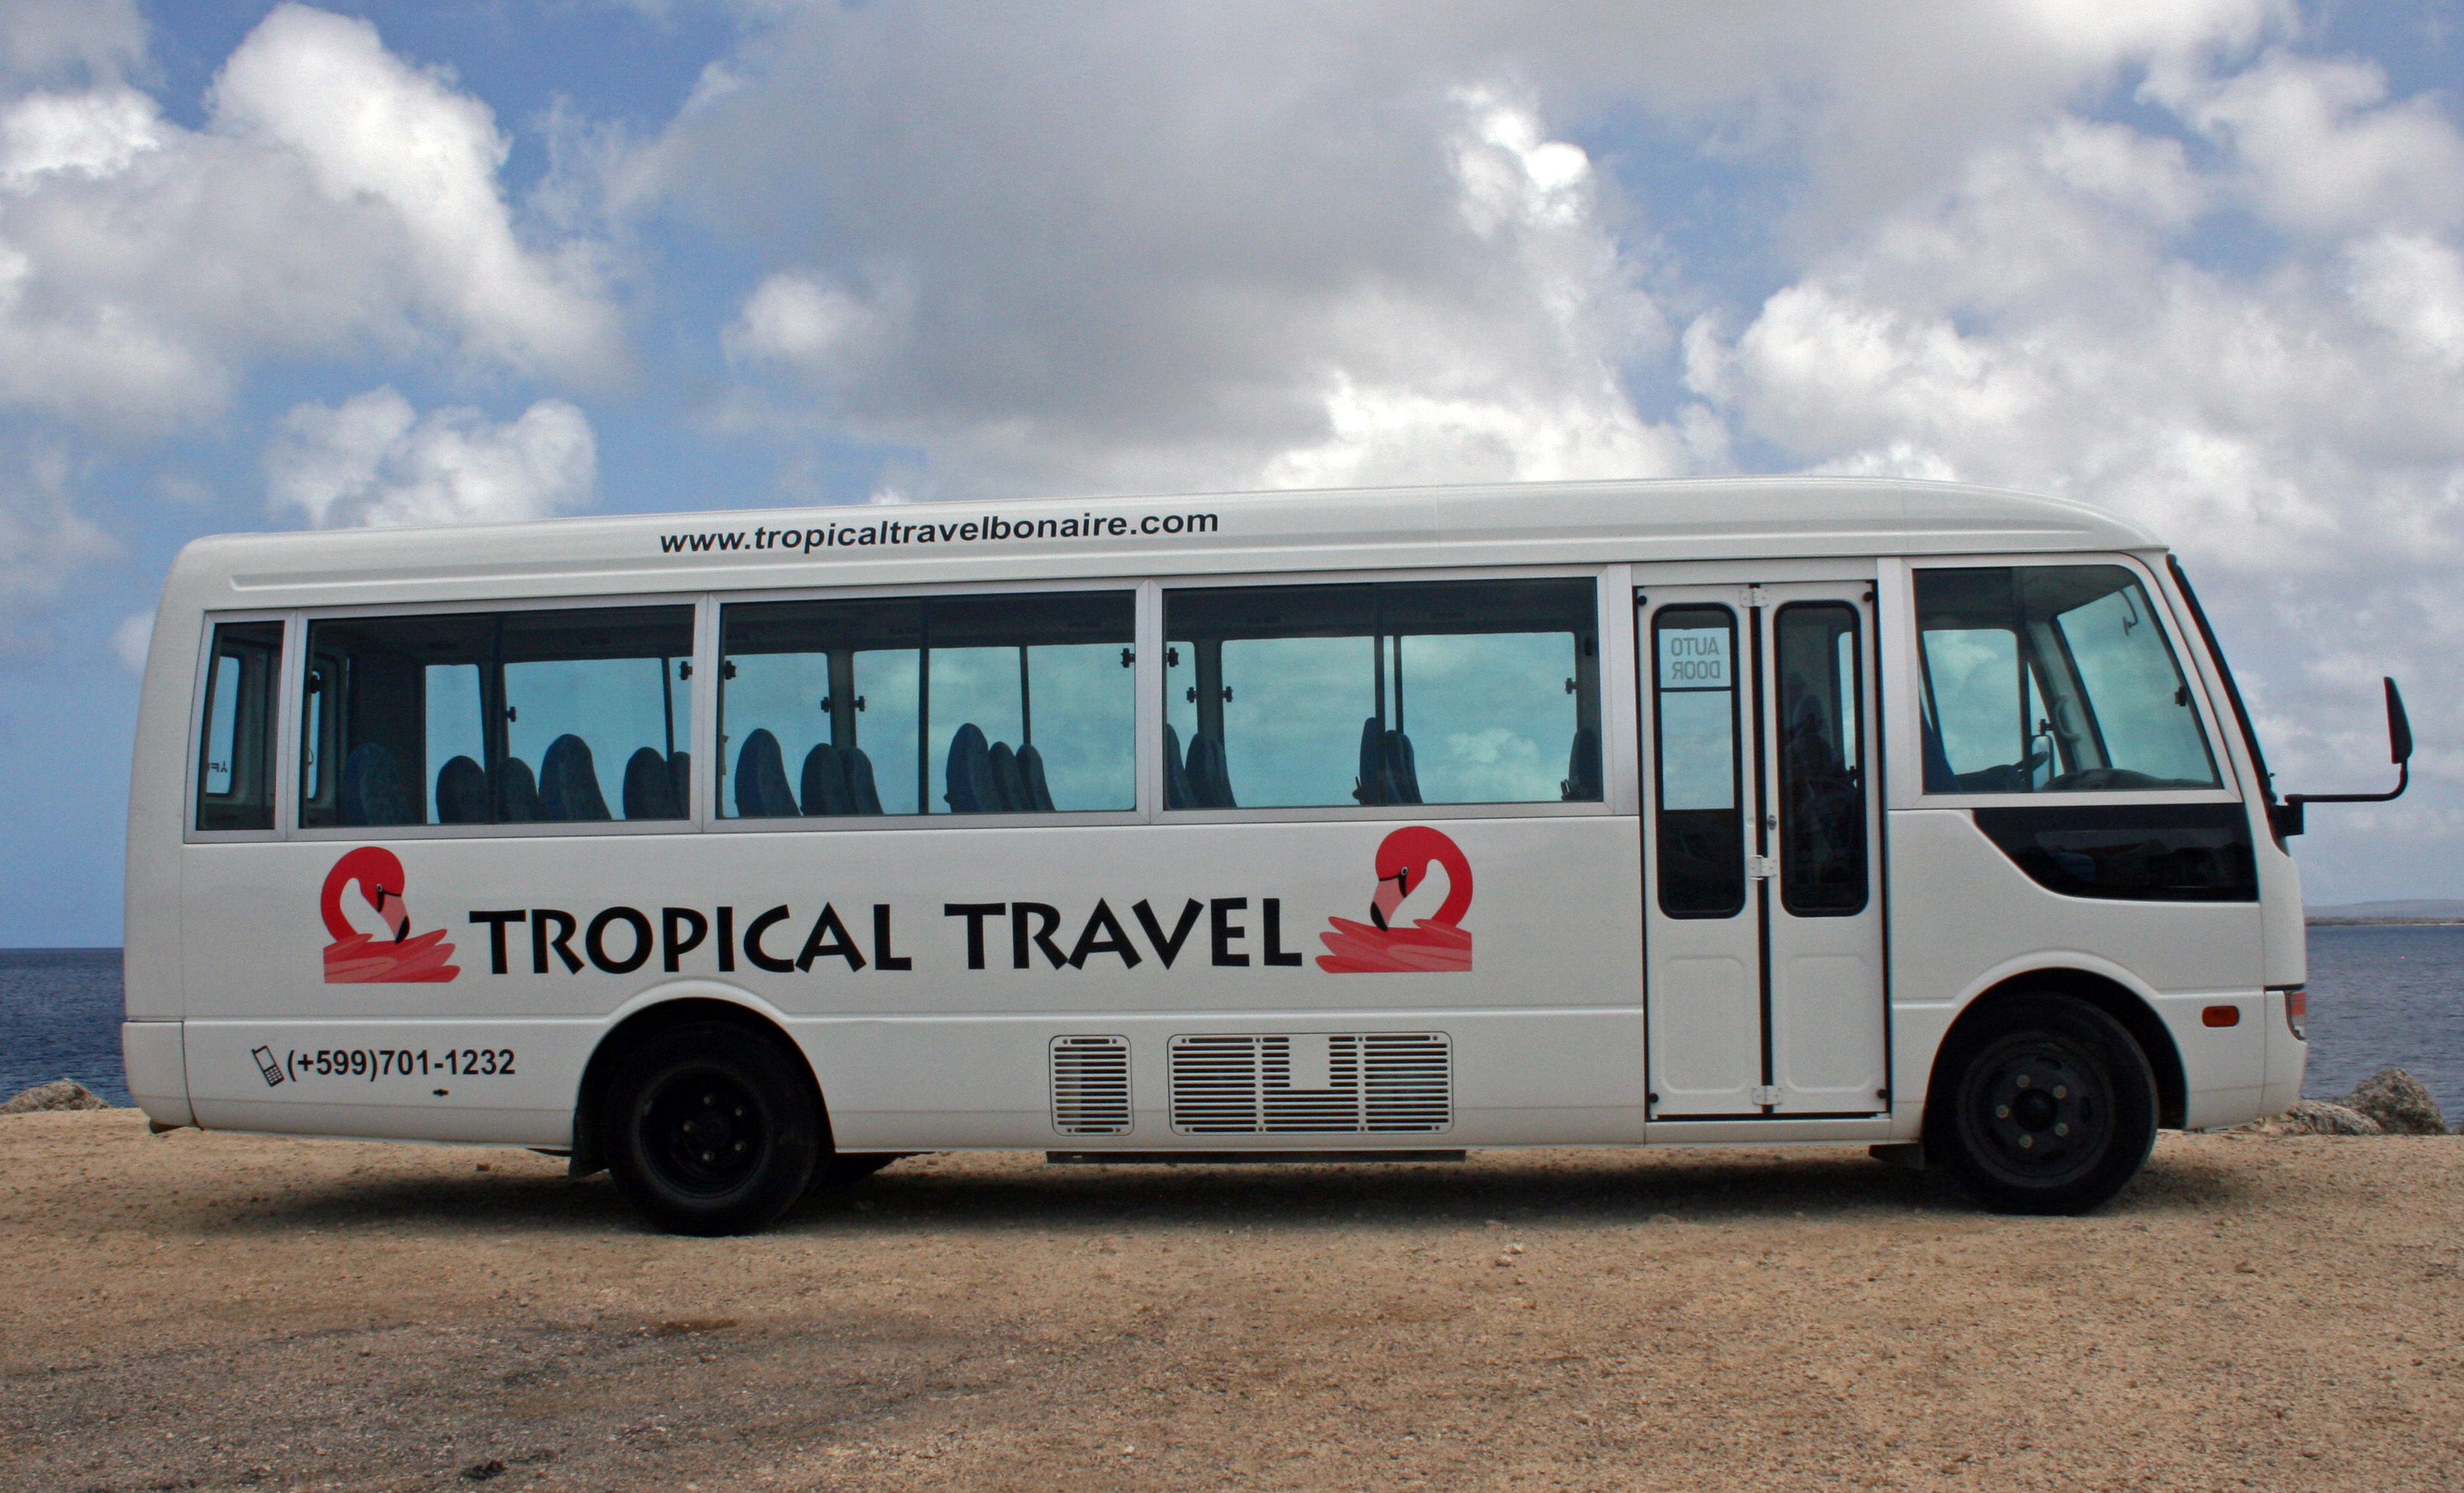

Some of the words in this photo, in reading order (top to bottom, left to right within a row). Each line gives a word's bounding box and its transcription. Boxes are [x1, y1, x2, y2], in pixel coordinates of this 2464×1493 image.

[661, 513, 1218, 554] www.tropicaltravelbonaire.com
[469, 902, 911, 974] TROPICAL
[944, 896, 1302, 970] TRAVEL
[288, 1049, 516, 1082] (+599)701-1232
